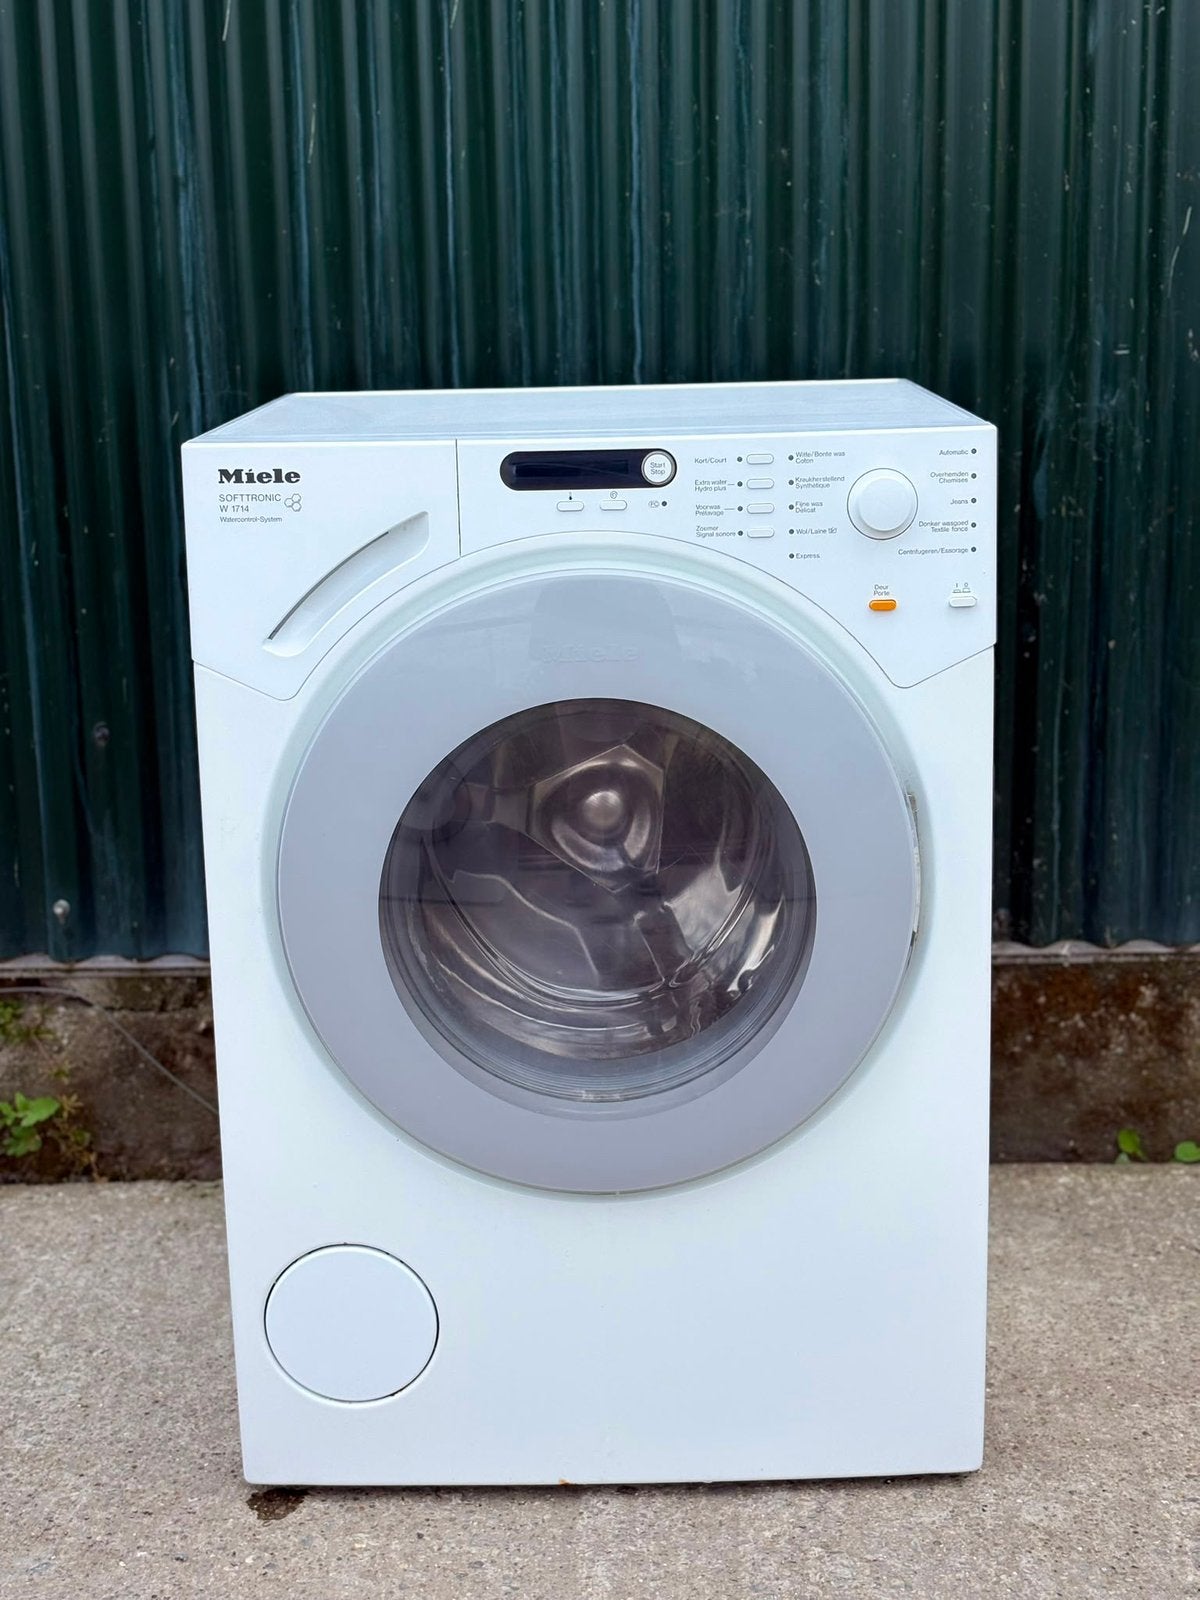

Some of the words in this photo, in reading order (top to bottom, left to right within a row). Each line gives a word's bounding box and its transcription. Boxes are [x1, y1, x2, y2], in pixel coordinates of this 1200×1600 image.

[218, 468, 301, 484] Miele
[650, 468, 666, 476] Stop
[218, 494, 282, 502] SOFTTRONIC
[219, 504, 229, 513] W
[231, 504, 250, 513] 1714
[796, 527, 827, 535] Wol/Laine
[796, 552, 820, 560] Express
[898, 548, 969, 556] Centrifugeren/Essorage
